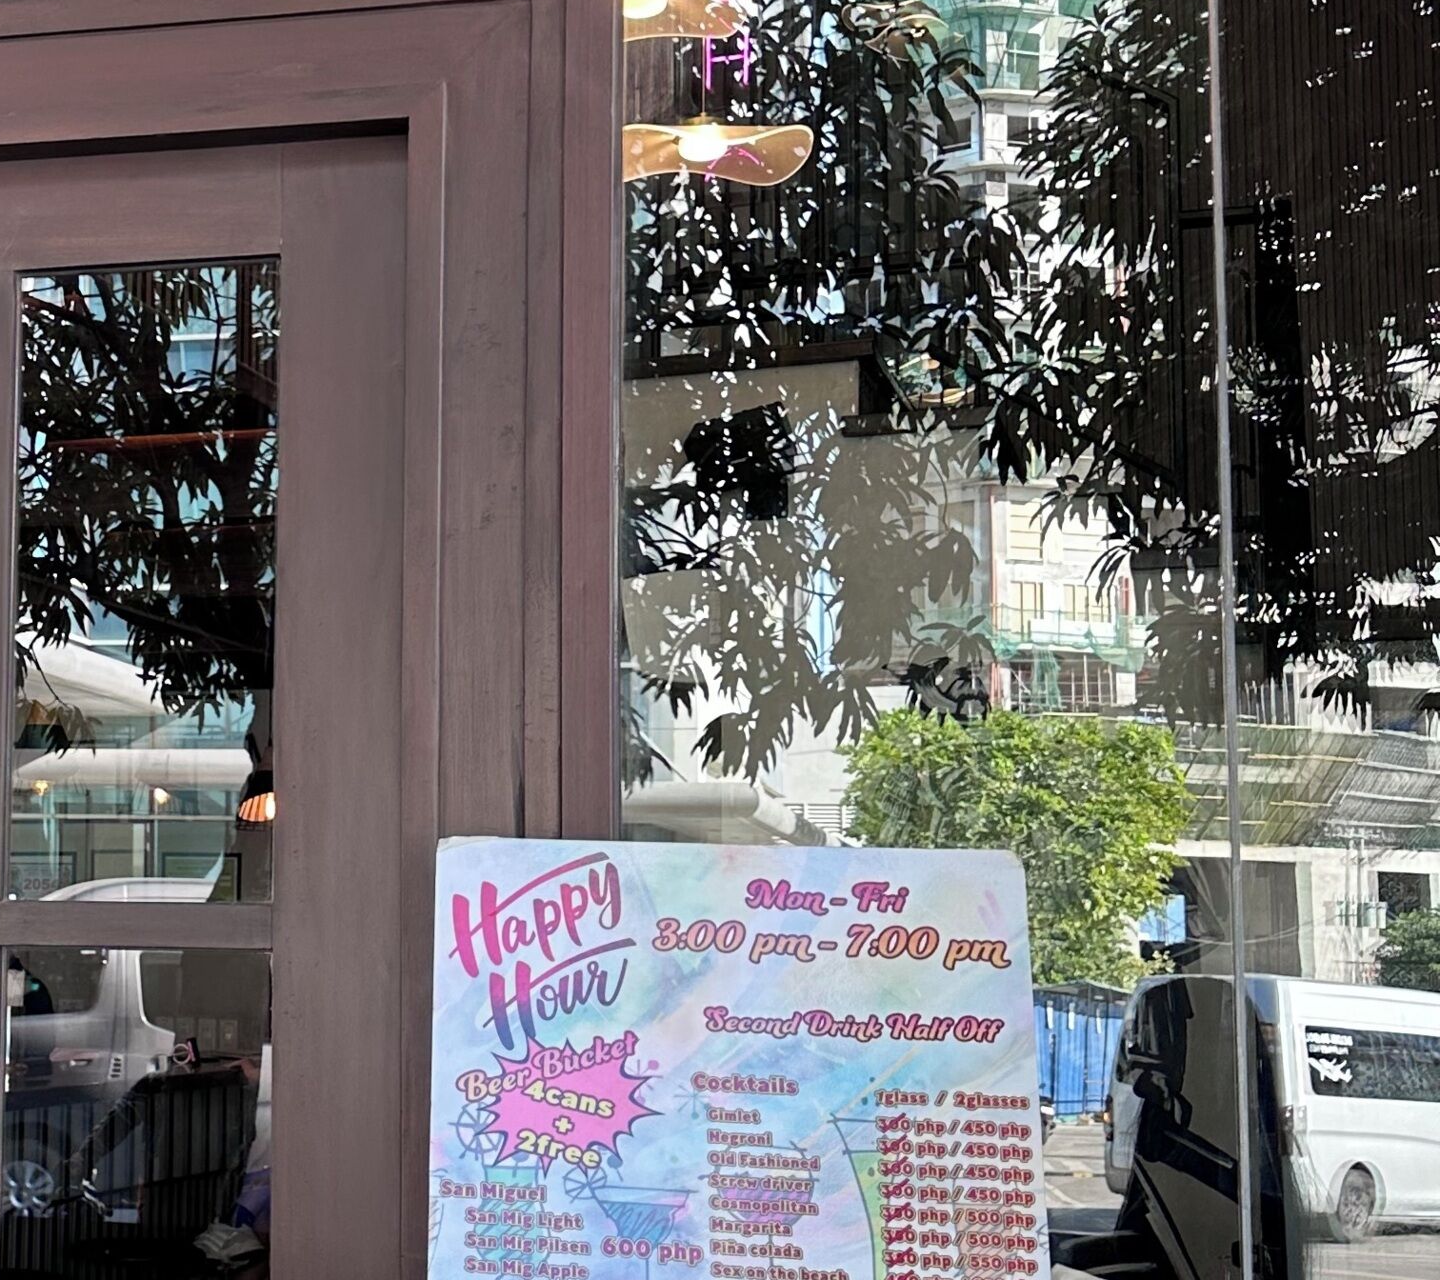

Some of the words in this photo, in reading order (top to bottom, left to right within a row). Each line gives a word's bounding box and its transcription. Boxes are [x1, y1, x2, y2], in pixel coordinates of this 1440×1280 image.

[745, 878, 829, 916] Mon
[852, 881, 909, 913] Fri
[449, 852, 621, 978] Happy
[652, 917, 746, 952] 3:00
[749, 932, 816, 963] pm
[845, 923, 940, 959] 7:00
[943, 937, 1011, 970] pm
[482, 938, 637, 1051] Hour
[703, 1005, 803, 1038] Second
[803, 1010, 883, 1043] Drink
[885, 1013, 953, 1042] Half
[953, 1015, 1004, 1043] Off
[456, 1067, 531, 1103] Beer
[532, 1030, 639, 1080] Bucket
[691, 1071, 799, 1096] Cocktails
[707, 1107, 761, 1124] Gimlet
[707, 1129, 773, 1148] Negroni
[915, 1120, 946, 1136] php
[961, 1121, 998, 1136] 450
[999, 1123, 1031, 1140] php
[708, 1152, 736, 1166] Old
[738, 1154, 821, 1171] Fashioned
[916, 1141, 947, 1159] php
[963, 1143, 999, 1158] 450
[1001, 1145, 1033, 1162] php
[708, 1174, 757, 1190] Screw
[762, 1176, 813, 1193] driver
[917, 1163, 949, 1181] php
[964, 1165, 1000, 1180] 450
[1002, 1168, 1034, 1184] php
[440, 1179, 478, 1199] San
[481, 1182, 548, 1203] Miguel
[919, 1185, 950, 1202] php
[965, 1188, 1001, 1202] 450
[1003, 1190, 1035, 1207] php
[709, 1196, 819, 1216] Cosmopolitan
[465, 1208, 497, 1225] San
[502, 1210, 533, 1228] Mig
[536, 1211, 583, 1230] Light
[710, 1218, 793, 1237] Margarita
[919, 1208, 950, 1225] php
[966, 1210, 1002, 1225] 500
[1003, 1212, 1036, 1230] php
[465, 1233, 497, 1249] San
[502, 1234, 532, 1253] Mig
[536, 1236, 591, 1255] Pilsen
[601, 1238, 652, 1259] 600
[658, 1244, 704, 1267] php
[749, 1242, 803, 1260] colada
[920, 1231, 952, 1248] php
[967, 1233, 1003, 1248] 500
[1005, 1236, 1037, 1252] php
[464, 1256, 497, 1273] San
[502, 1258, 532, 1277] Mig
[536, 1261, 589, 1280] Apple
[711, 1262, 745, 1279] Sex
[746, 1266, 766, 1280] on
[921, 1253, 953, 1270] php
[969, 1256, 1005, 1271] 550
[1006, 1259, 1038, 1276] php
